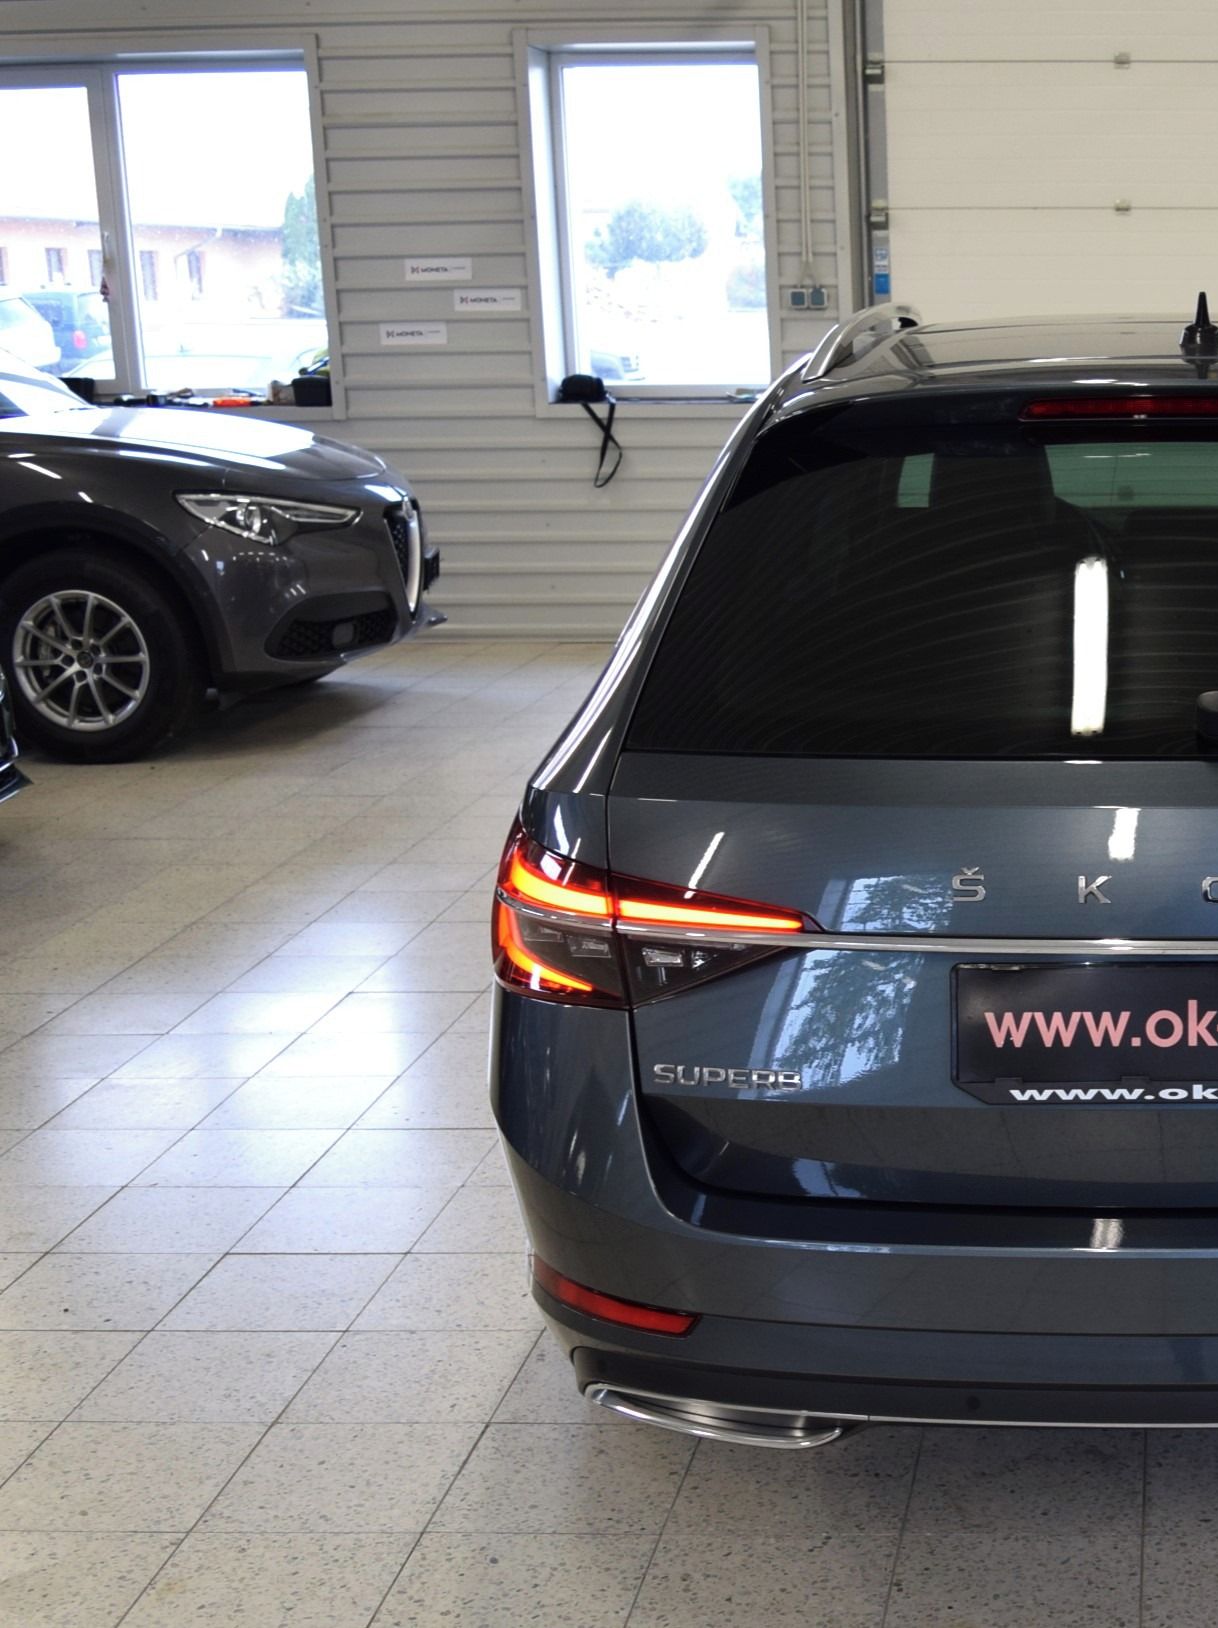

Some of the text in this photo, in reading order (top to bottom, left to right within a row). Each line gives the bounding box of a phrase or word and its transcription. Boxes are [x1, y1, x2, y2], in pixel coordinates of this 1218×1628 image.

[420, 266, 449, 274] MONETA
[469, 296, 498, 304] MONETA
[653, 1063, 802, 1092] SUPERB
